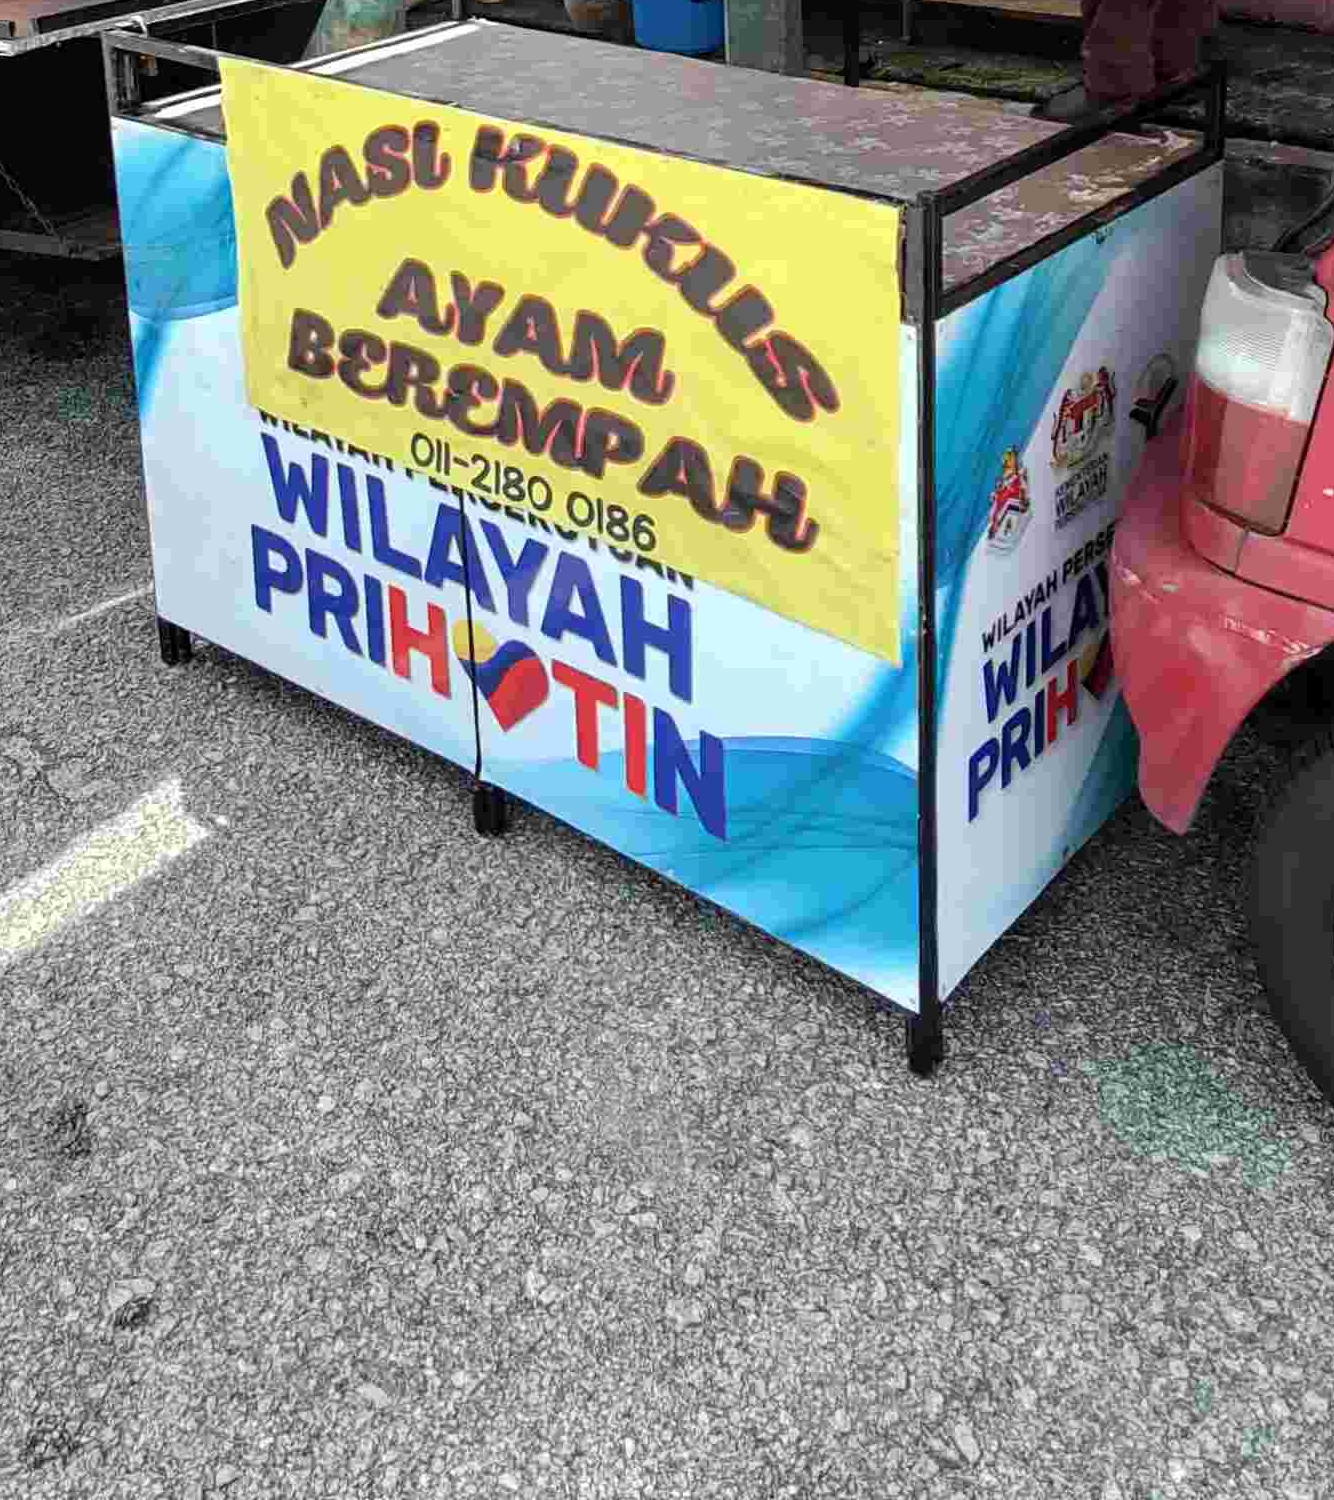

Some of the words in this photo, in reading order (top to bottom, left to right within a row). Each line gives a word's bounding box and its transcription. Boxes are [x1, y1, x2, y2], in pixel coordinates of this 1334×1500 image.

[265, 119, 452, 270] NASI
[468, 123, 841, 423] KUKUS
[376, 257, 675, 404] AYAM
[287, 307, 820, 554] BEREMPAH
[410, 432, 553, 512] 011-2180
[565, 490, 658, 552] 0186
[250, 523, 728, 842] PRIHTIN
[260, 432, 693, 706] WILAYAH
[982, 568, 1058, 653] WILAYAH
